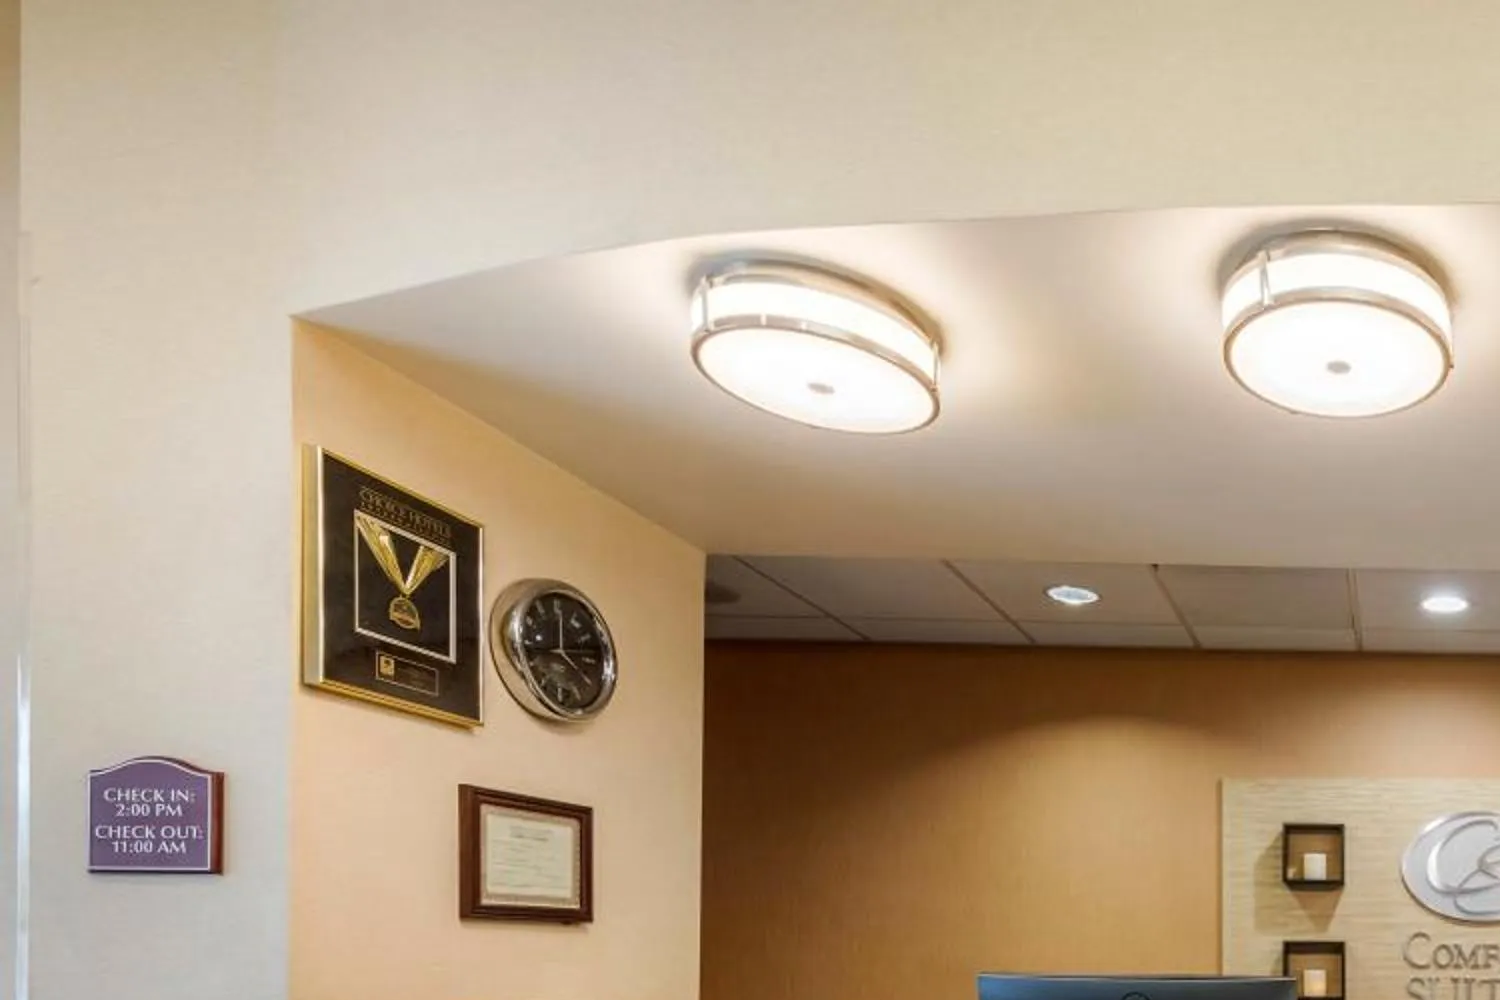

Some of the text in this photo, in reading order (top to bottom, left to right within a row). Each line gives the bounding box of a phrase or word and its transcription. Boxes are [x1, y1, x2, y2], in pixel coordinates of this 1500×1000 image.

[103, 787, 196, 803] CHECK IN:
[115, 803, 183, 817] 2:00 PM
[95, 825, 204, 839] CHECK OUT:
[111, 840, 187, 854] 11:00 AM
